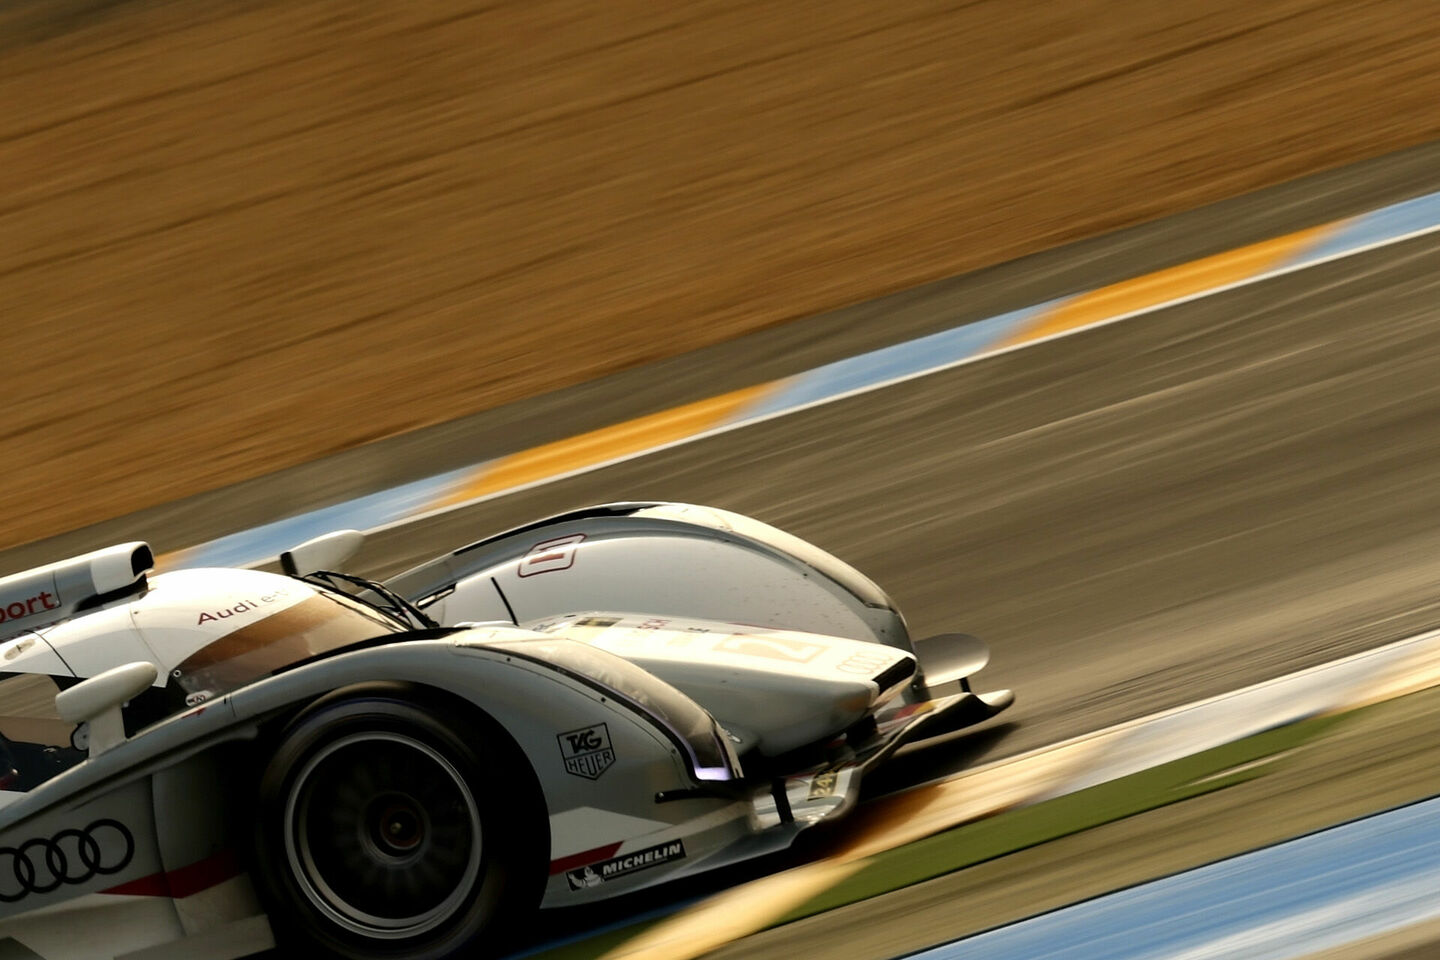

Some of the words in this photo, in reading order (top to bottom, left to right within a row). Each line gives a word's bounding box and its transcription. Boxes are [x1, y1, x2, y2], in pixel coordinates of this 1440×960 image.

[197, 599, 259, 625] Audi
[566, 730, 602, 753] TAG
[568, 751, 612, 776] HEUER
[602, 843, 682, 876] MICHELIN
